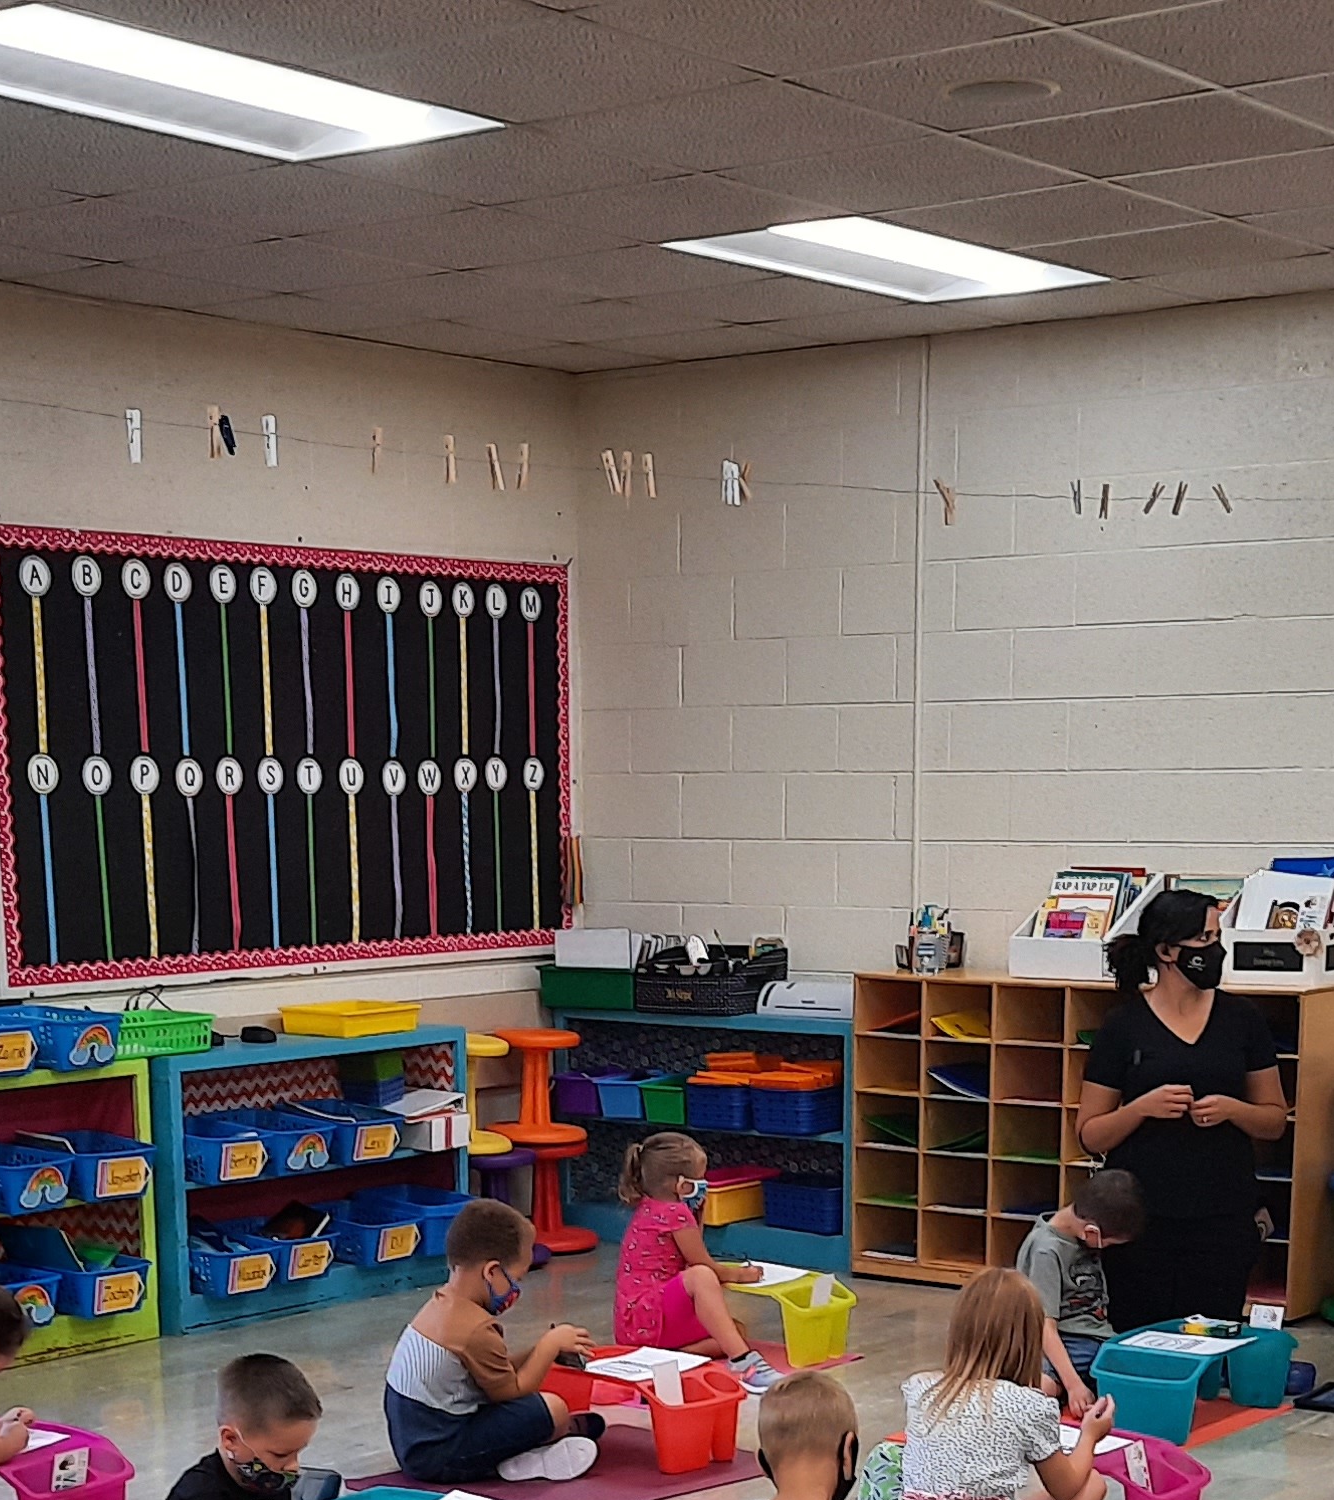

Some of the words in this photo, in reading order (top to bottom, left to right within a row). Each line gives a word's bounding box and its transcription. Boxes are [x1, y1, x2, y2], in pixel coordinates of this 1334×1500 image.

[29, 564, 43, 587] A
[81, 563, 93, 587] B
[130, 568, 142, 590] C
[171, 570, 183, 593] D
[218, 572, 229, 594] E
[257, 574, 267, 596] F
[299, 578, 309, 599] G
[341, 582, 352, 603] H
[384, 585, 393, 605] I
[425, 588, 435, 608] J
[458, 589, 469, 609] K
[492, 592, 501, 611] L
[524, 594, 537, 614] M
[36, 764, 49, 786] N
[91, 765, 103, 786] O
[140, 763, 150, 785] P
[184, 766, 196, 787] Q
[225, 765, 235, 786] R
[265, 765, 276, 786] S
[304, 765, 314, 785] T
[346, 767, 356, 786] U
[389, 768, 399, 787] V
[421, 767, 437, 788] W
[461, 766, 471, 785] X
[491, 764, 500, 783] Y
[529, 764, 538, 783] Z
